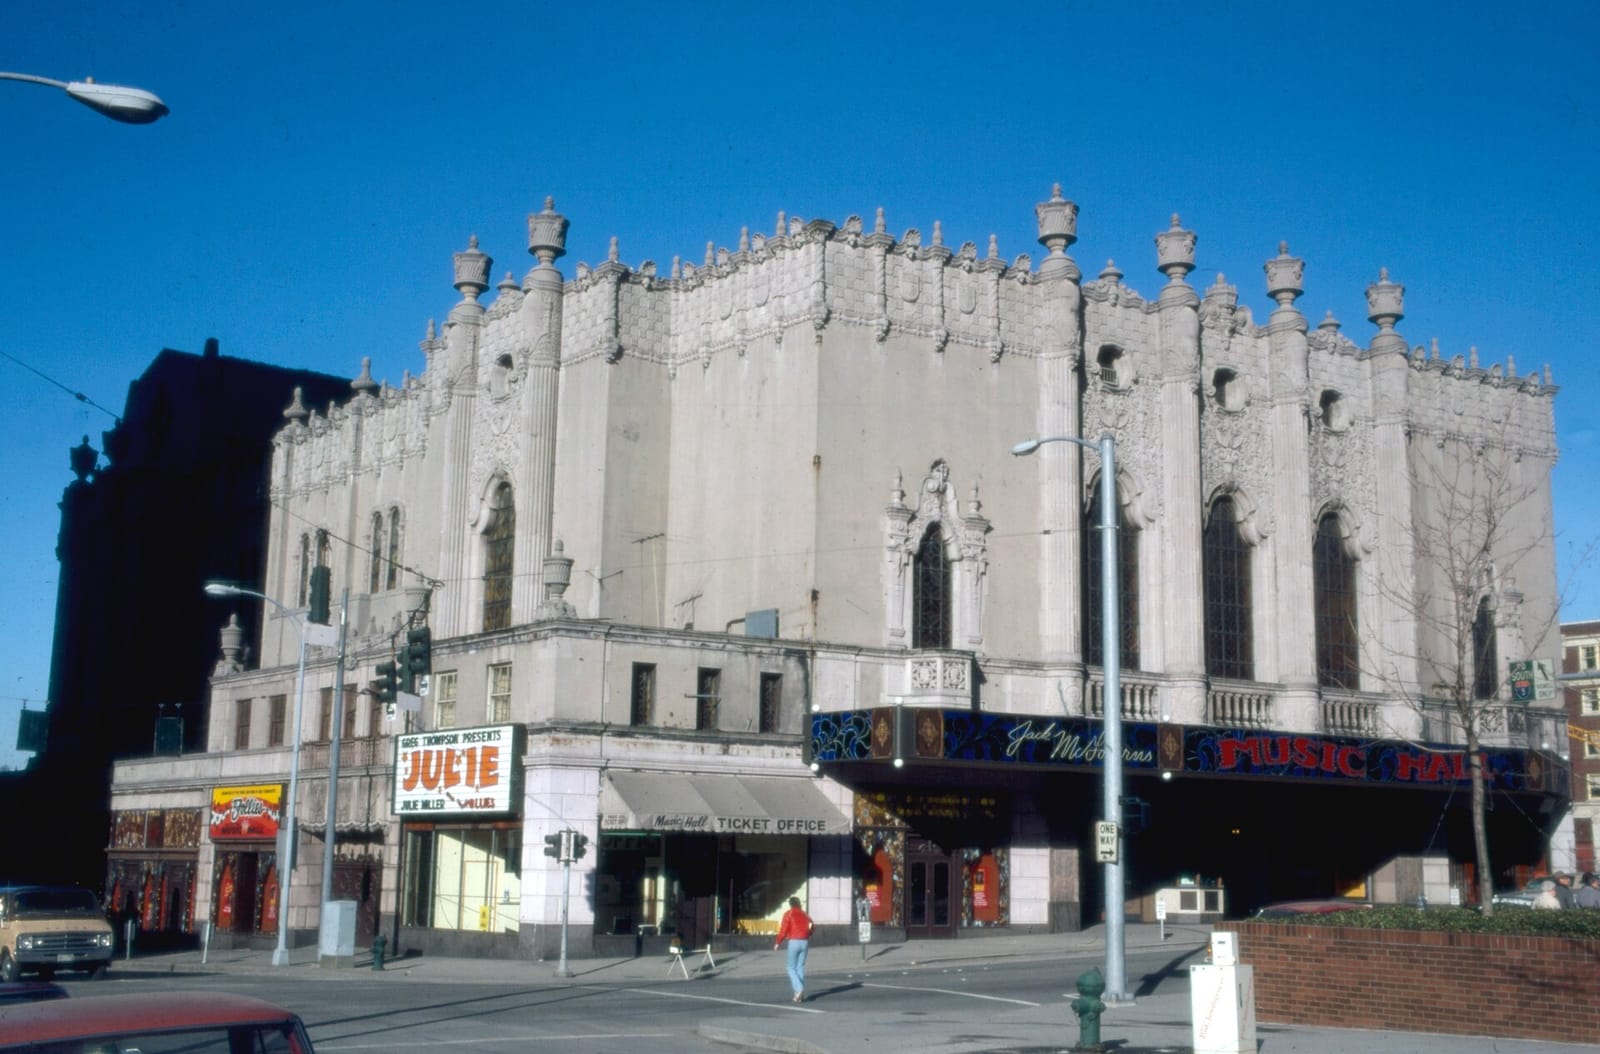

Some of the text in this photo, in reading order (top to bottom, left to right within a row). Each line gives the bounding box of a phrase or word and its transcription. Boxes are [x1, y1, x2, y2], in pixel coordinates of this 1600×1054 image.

[401, 729, 502, 748] GREG THOMPSON PRESENTS
[1006, 720, 1056, 757] Jack
[402, 745, 499, 792] JULIE
[1217, 737, 1498, 782] MUSIC HALL
[421, 798, 446, 811] MILLER
[654, 815, 826, 832] Music Hall TICKET OFFICE
[1100, 824, 1115, 834] ONE
[1100, 836, 1114, 845] WAY
